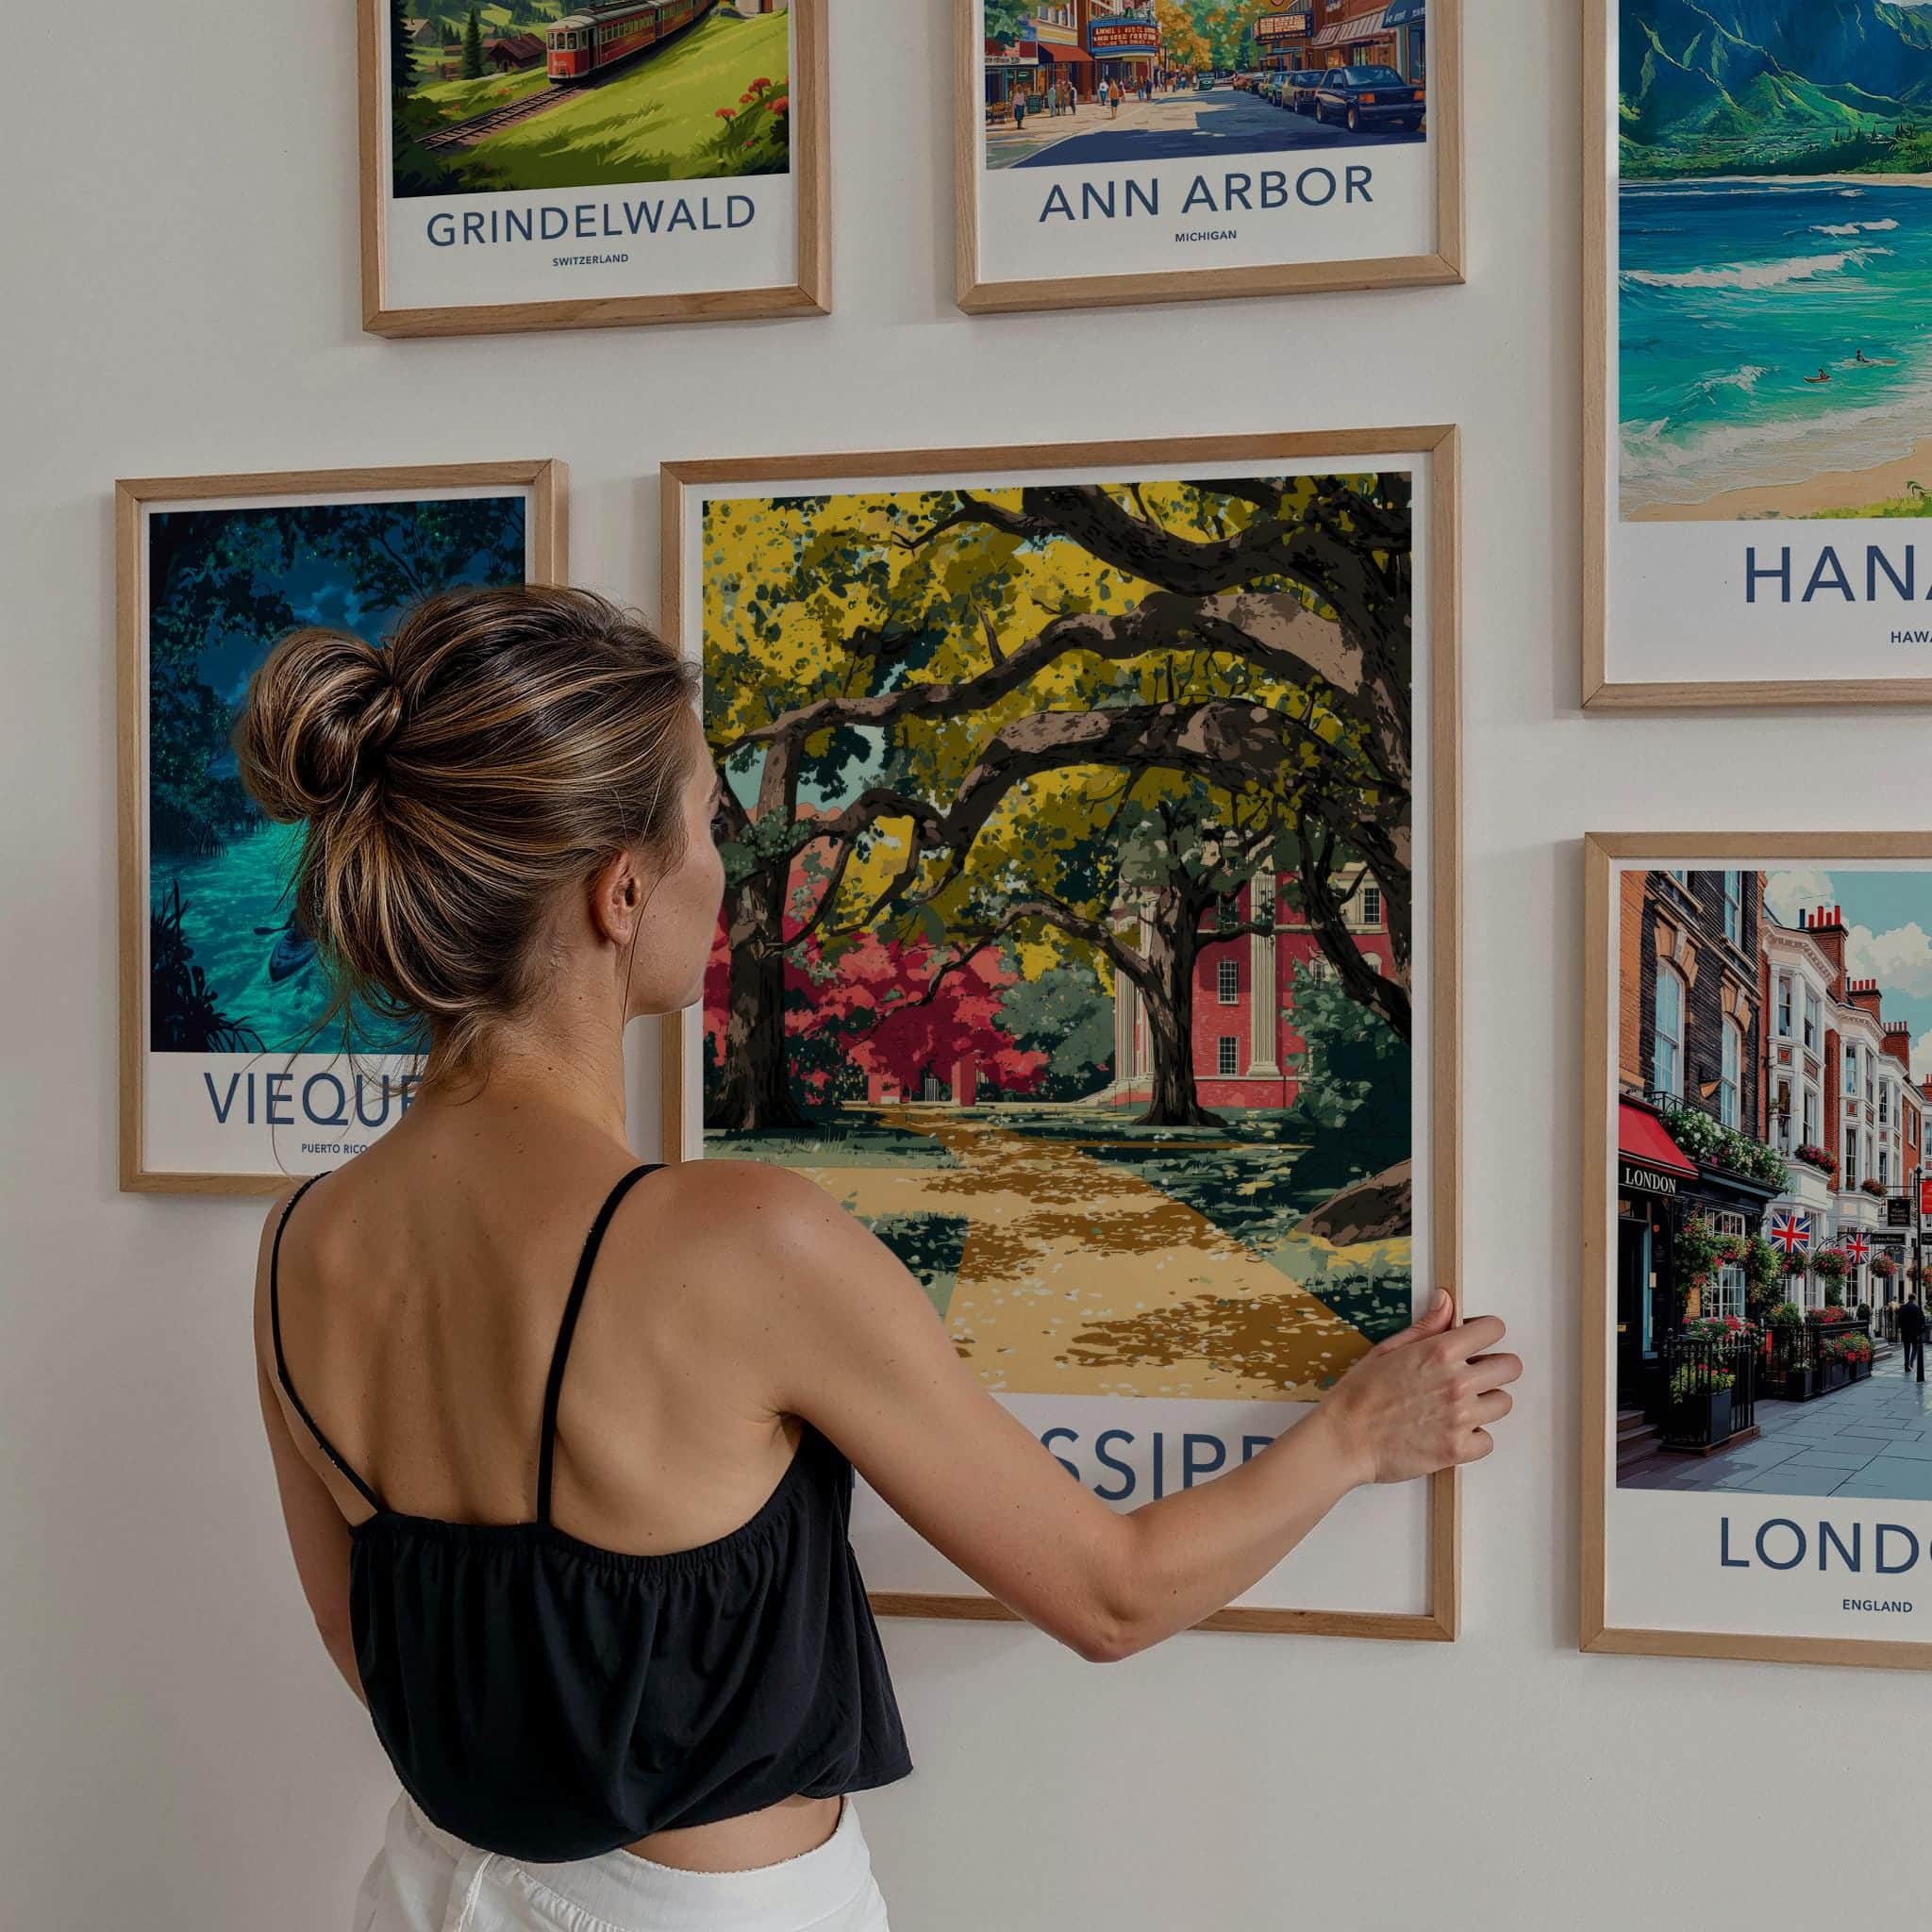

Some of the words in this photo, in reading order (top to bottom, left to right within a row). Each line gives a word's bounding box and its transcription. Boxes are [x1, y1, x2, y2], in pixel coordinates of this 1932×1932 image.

[1039, 177, 1159, 223] ANN
[1181, 165, 1374, 213] ARBOR
[426, 195, 755, 247] GRINDELWALD
[1174, 230, 1238, 242] MICHIGAN
[552, 254, 629, 267] SWITZERLAND
[1746, 544, 1932, 604] HAN
[1890, 630, 1932, 643] HAW
[301, 1142, 341, 1154] PUERTO
[343, 1144, 368, 1154] RICO
[1625, 1167, 1676, 1193] LONDON
[1721, 1517, 1932, 1574] LOND
[1842, 1599, 1913, 1613] ENGLAND
